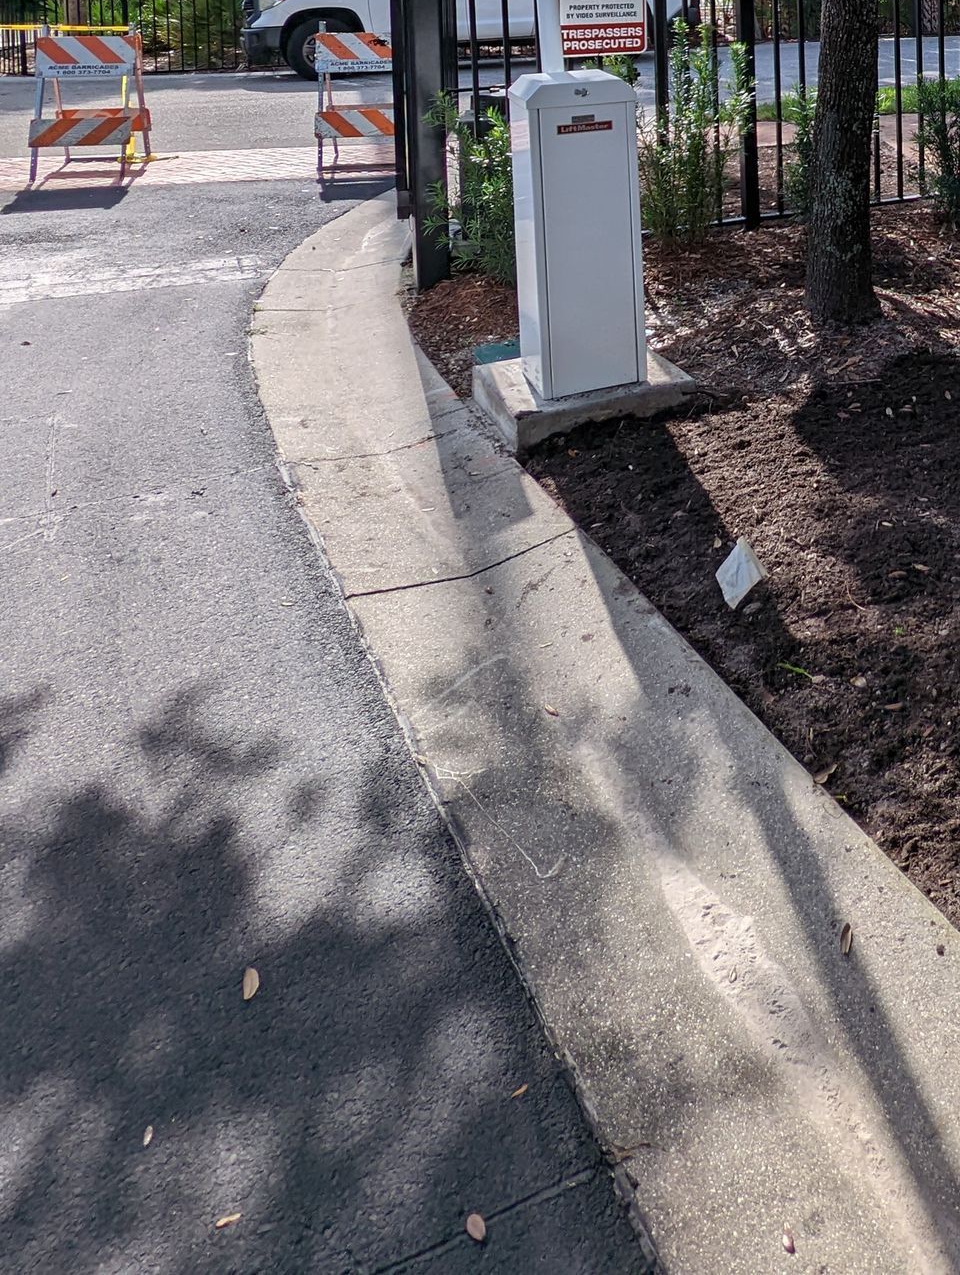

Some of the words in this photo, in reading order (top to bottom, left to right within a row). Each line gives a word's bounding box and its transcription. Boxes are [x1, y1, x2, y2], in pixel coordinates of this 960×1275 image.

[561, 27, 643, 39] TRESPASSERS
[563, 38, 641, 50] PROSECUTED
[560, 123, 609, 133] LiftMaster
